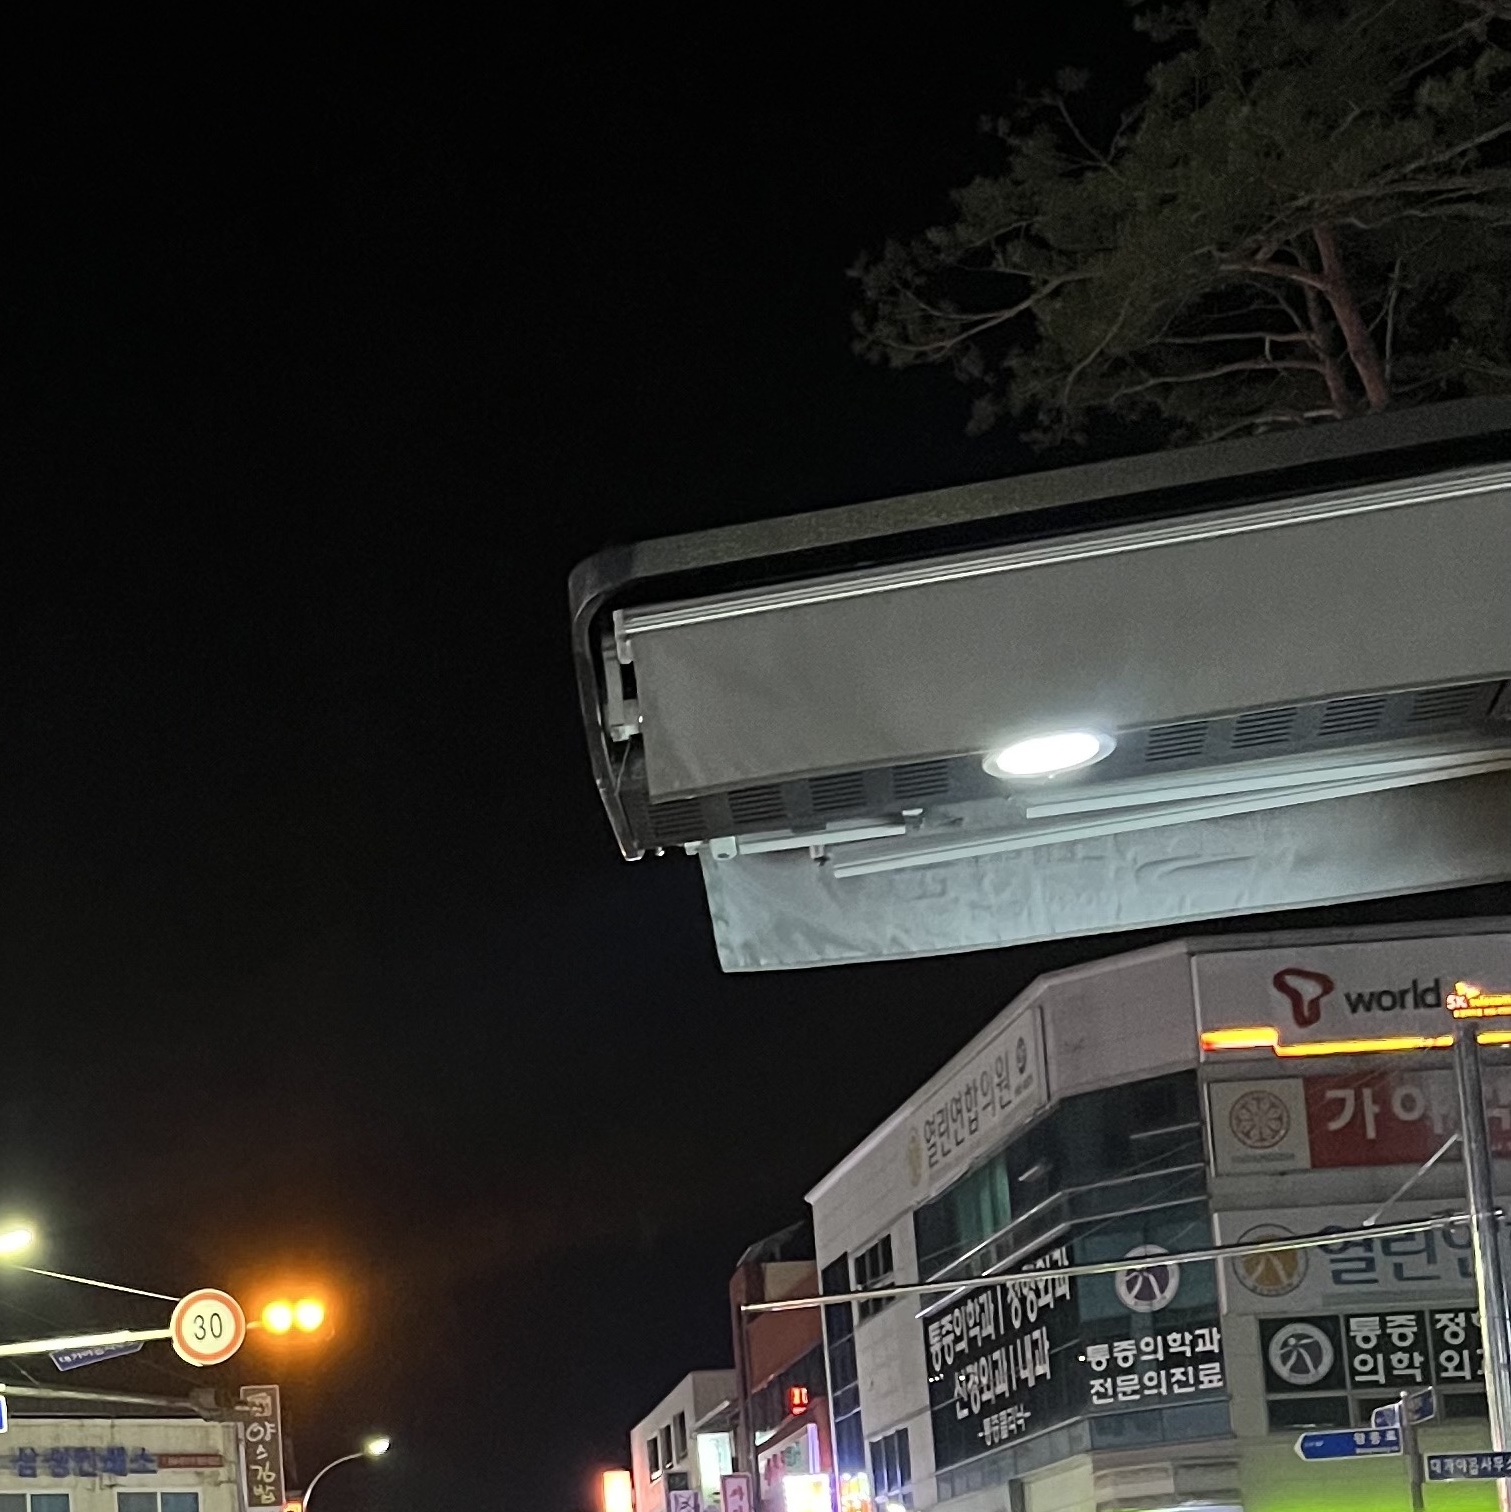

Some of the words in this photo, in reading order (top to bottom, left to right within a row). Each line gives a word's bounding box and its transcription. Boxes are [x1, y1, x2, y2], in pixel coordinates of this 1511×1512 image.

[1344, 978, 1442, 1014] world
[924, 1050, 1012, 1168] 열린연합의원
[193, 1312, 223, 1341] 30
[928, 1289, 996, 1372] 통증의학과
[1086, 1326, 1221, 1371] 통증의학과
[1349, 1315, 1418, 1349] 통증
[1016, 1326, 1052, 1388] 내과
[1353, 1352, 1424, 1384] 의학
[245, 1420, 277, 1505] 양스김밥
